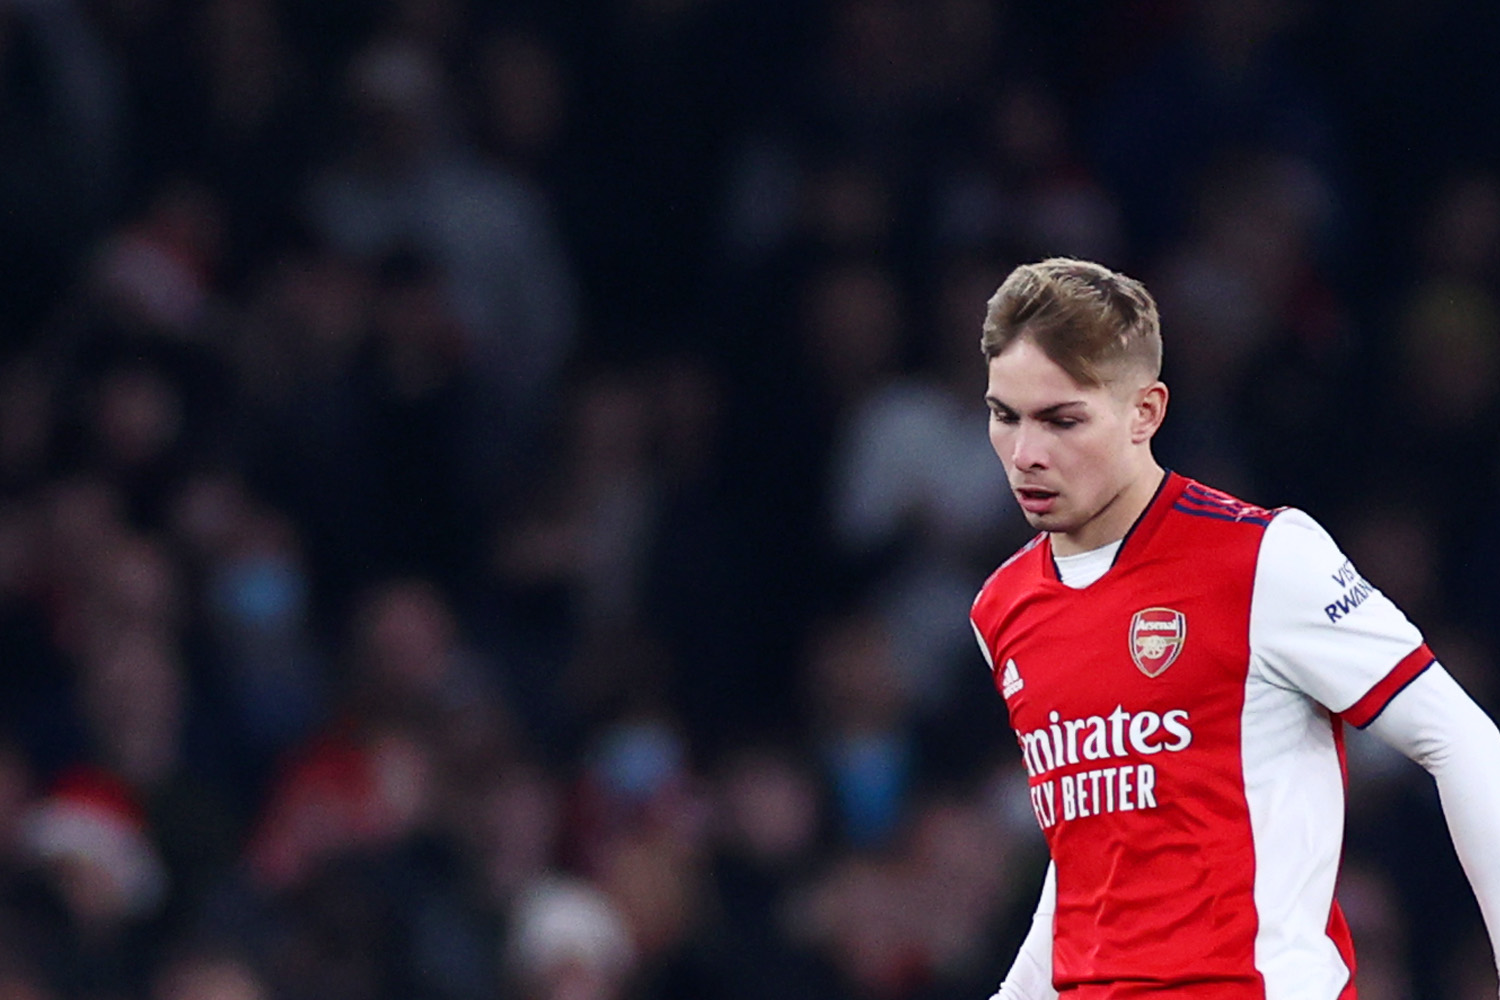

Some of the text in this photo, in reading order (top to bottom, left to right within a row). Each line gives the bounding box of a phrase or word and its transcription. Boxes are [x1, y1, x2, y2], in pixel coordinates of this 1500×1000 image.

[1332, 559, 1355, 588] VIS
[1324, 579, 1374, 624] RWAN
[1015, 704, 1193, 777] mirates
[1061, 764, 1157, 821] BETTER
